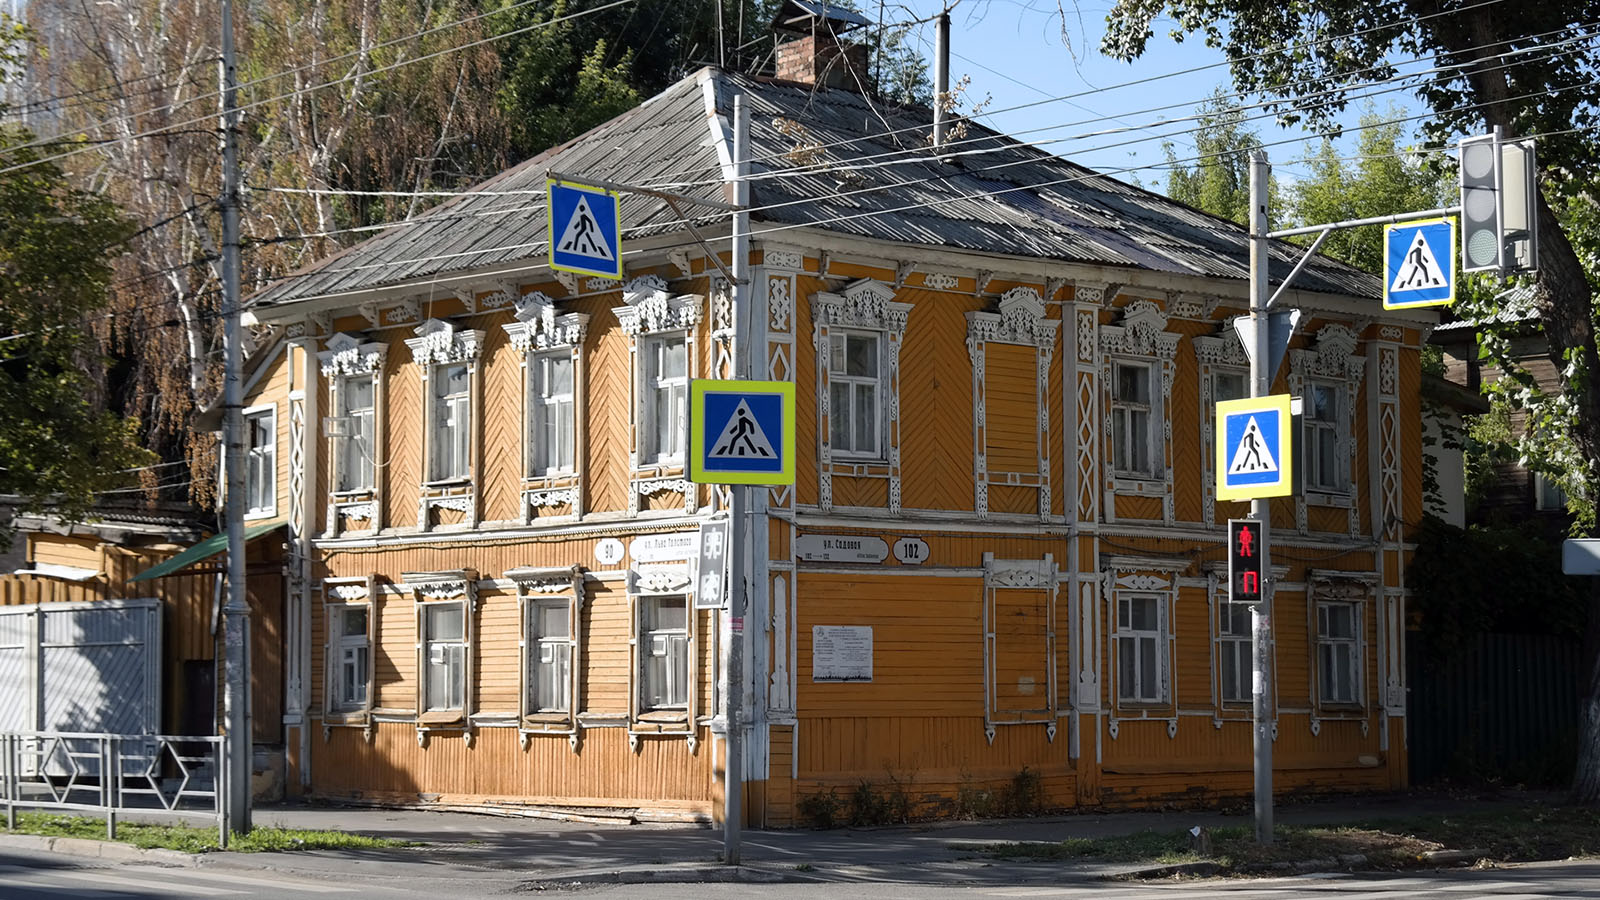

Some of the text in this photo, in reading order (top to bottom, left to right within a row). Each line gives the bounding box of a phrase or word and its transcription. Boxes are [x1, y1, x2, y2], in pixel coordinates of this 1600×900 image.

[605, 544, 613, 559] 90
[823, 539, 861, 550] ул. Садовая
[904, 543, 919, 558] 102
